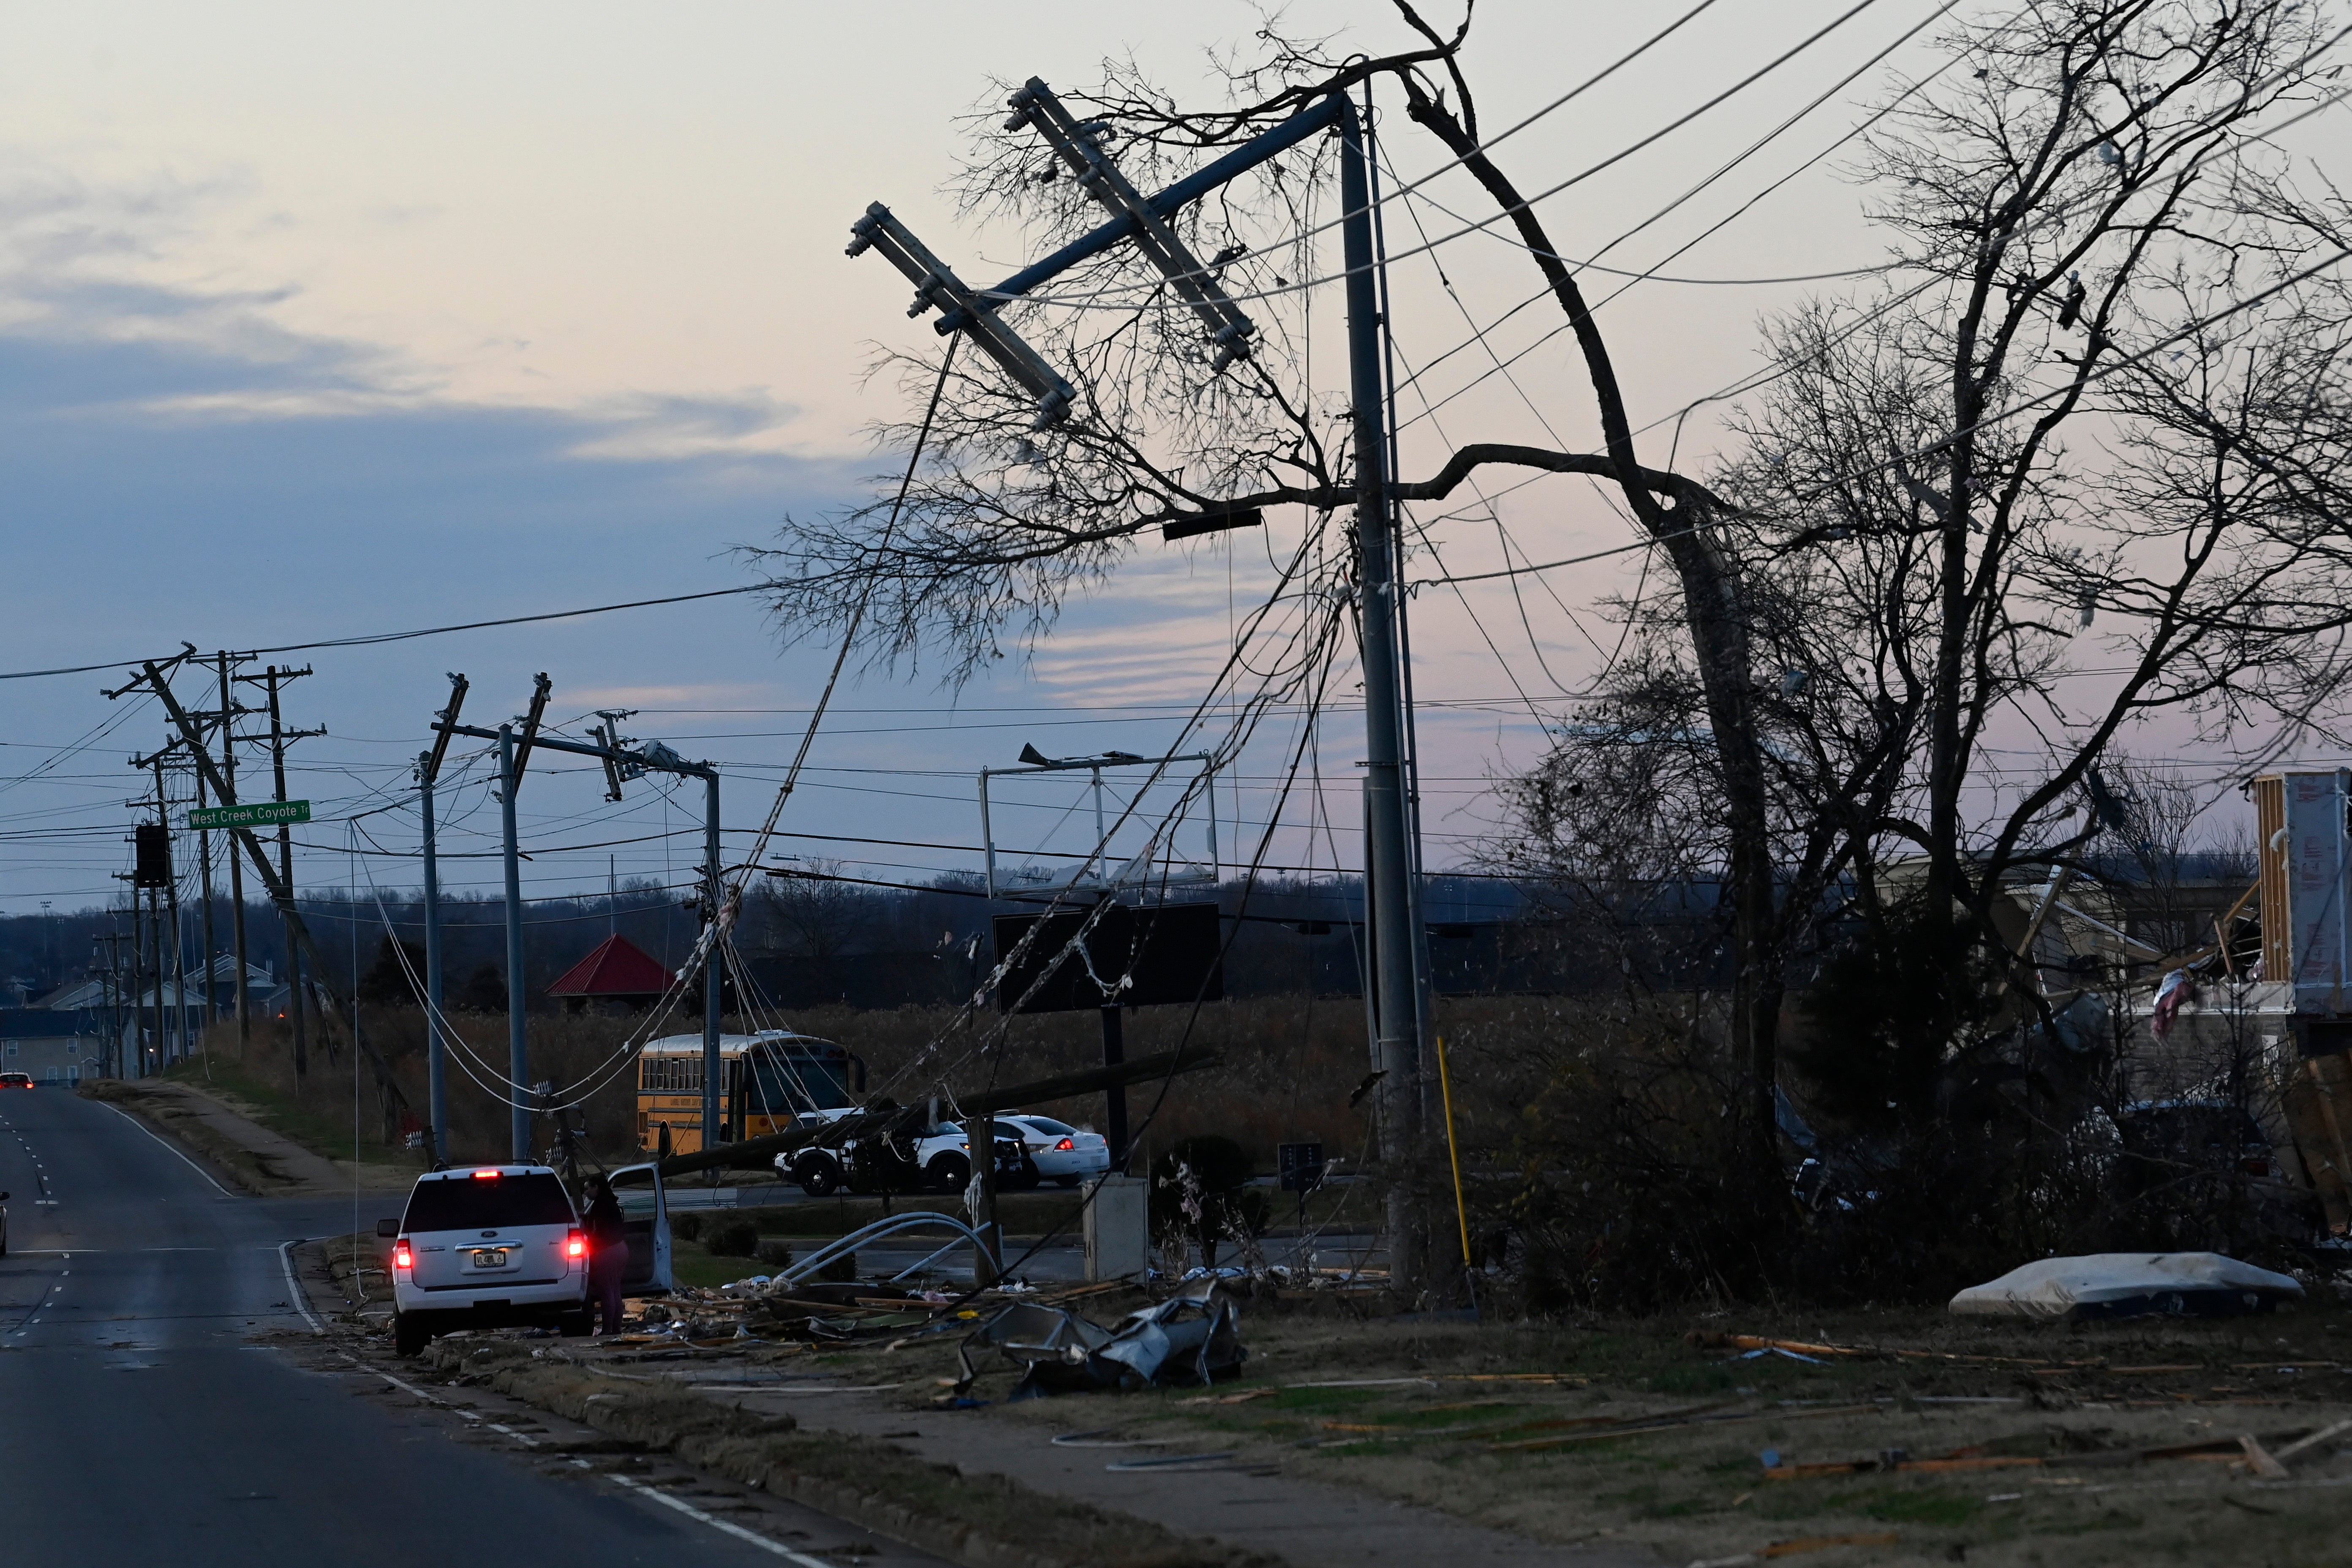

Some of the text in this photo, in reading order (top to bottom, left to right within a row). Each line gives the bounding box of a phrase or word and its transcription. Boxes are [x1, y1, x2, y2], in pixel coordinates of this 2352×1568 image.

[191, 805, 308, 825] West Creek Coyote Tr
